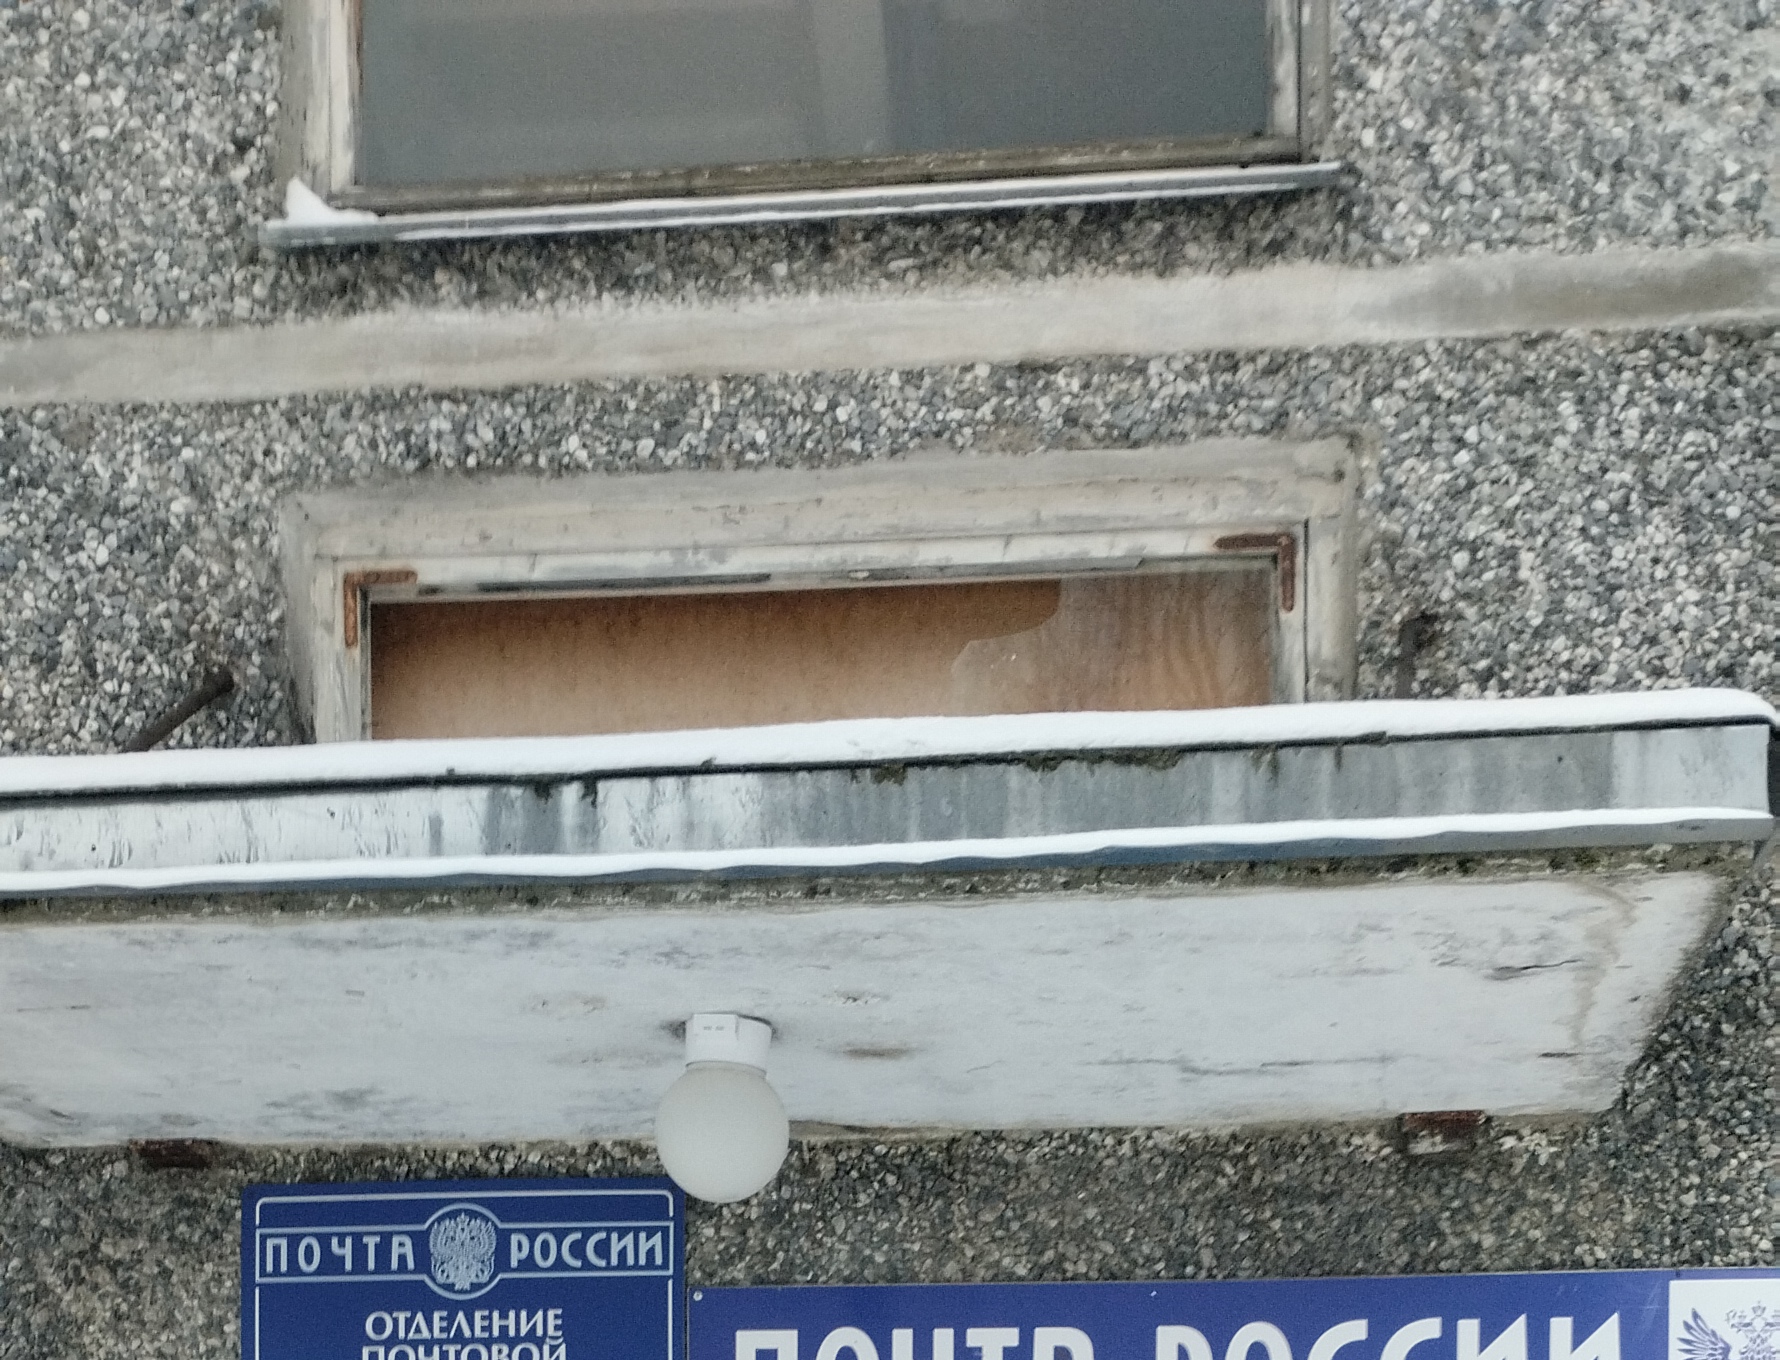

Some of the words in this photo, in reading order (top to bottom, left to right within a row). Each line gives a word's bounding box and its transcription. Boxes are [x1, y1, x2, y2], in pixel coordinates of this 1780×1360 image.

[266, 1234, 415, 1274] ПОЧТА
[510, 1231, 663, 1269] РОССИИ
[365, 1308, 563, 1342] ОТДЕЛЕНИЕ
